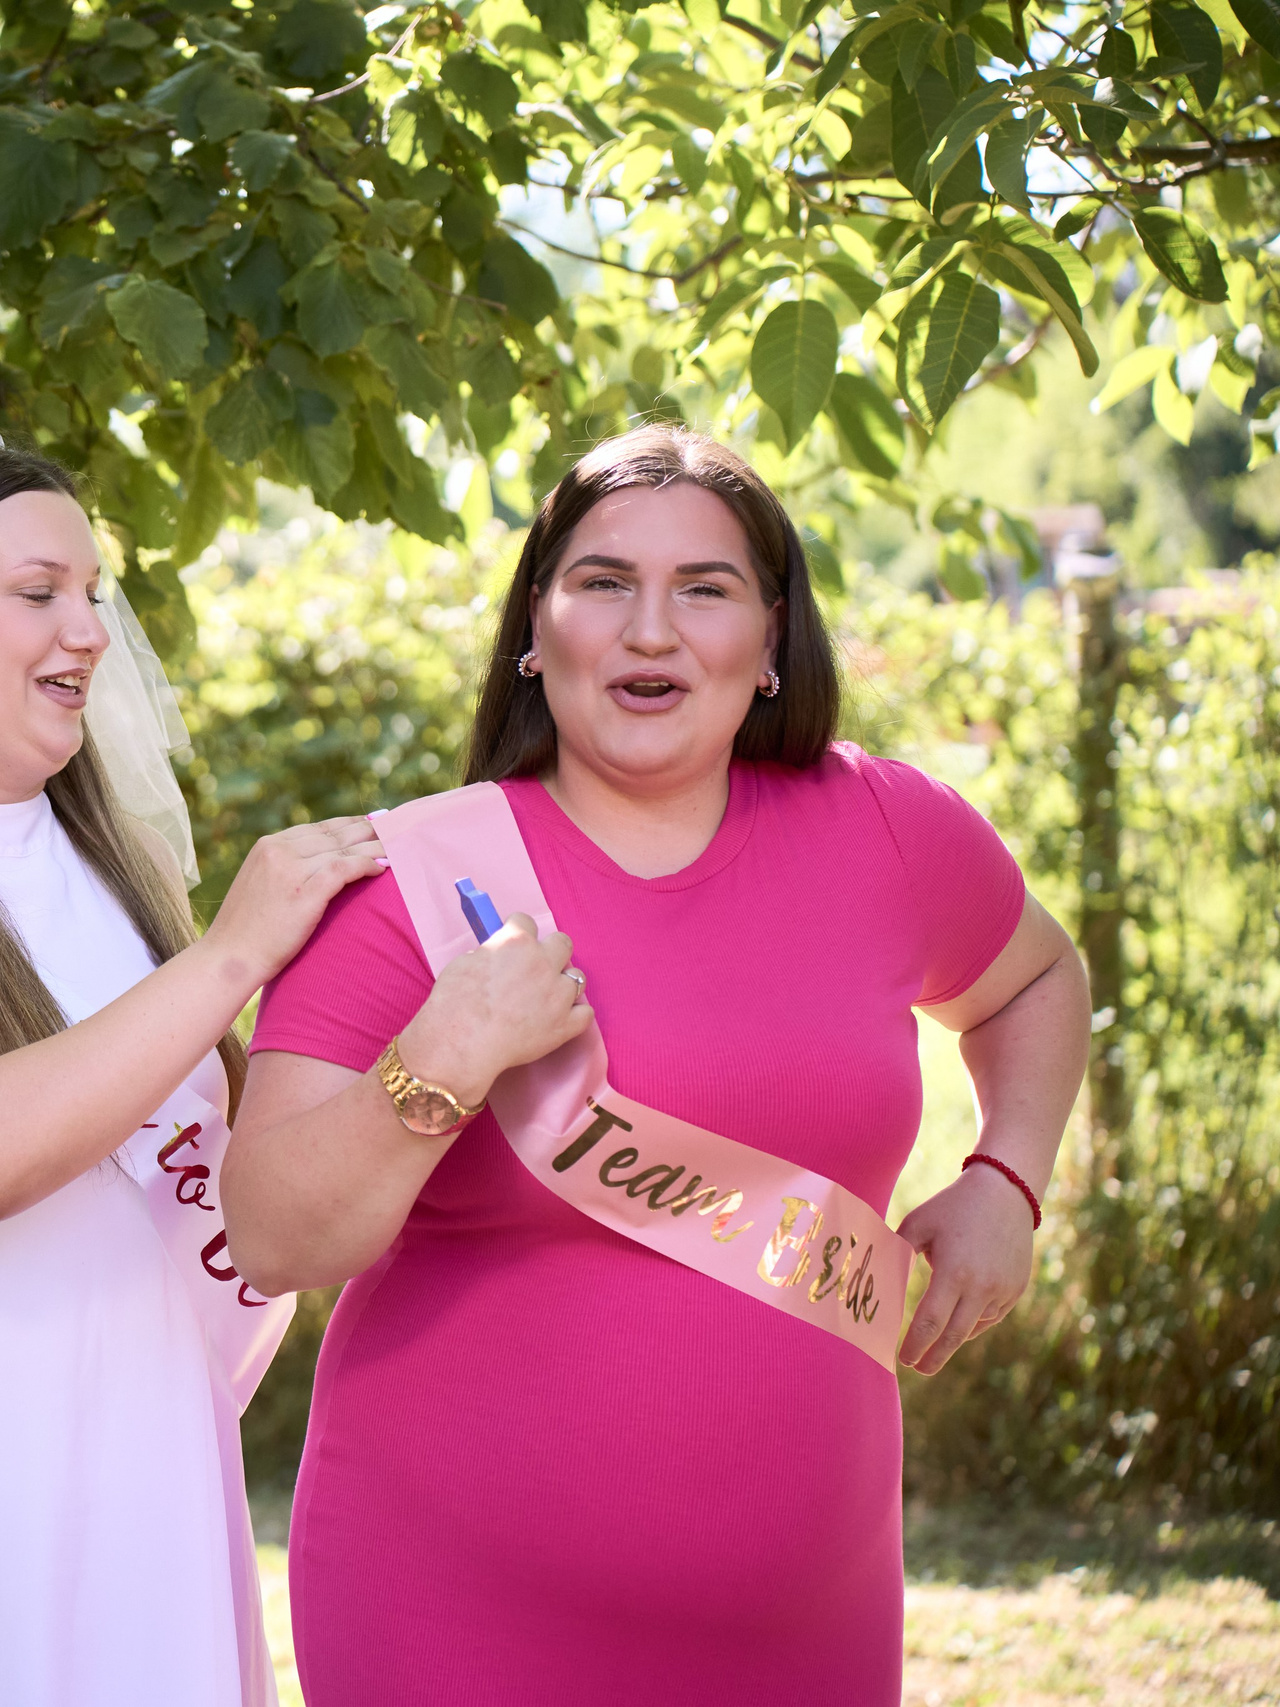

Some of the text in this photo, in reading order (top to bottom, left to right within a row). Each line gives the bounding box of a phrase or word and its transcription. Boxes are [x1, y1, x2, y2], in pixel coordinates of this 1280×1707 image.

[157, 1121, 216, 1212] to
[552, 1095, 880, 1325] Team Bride
